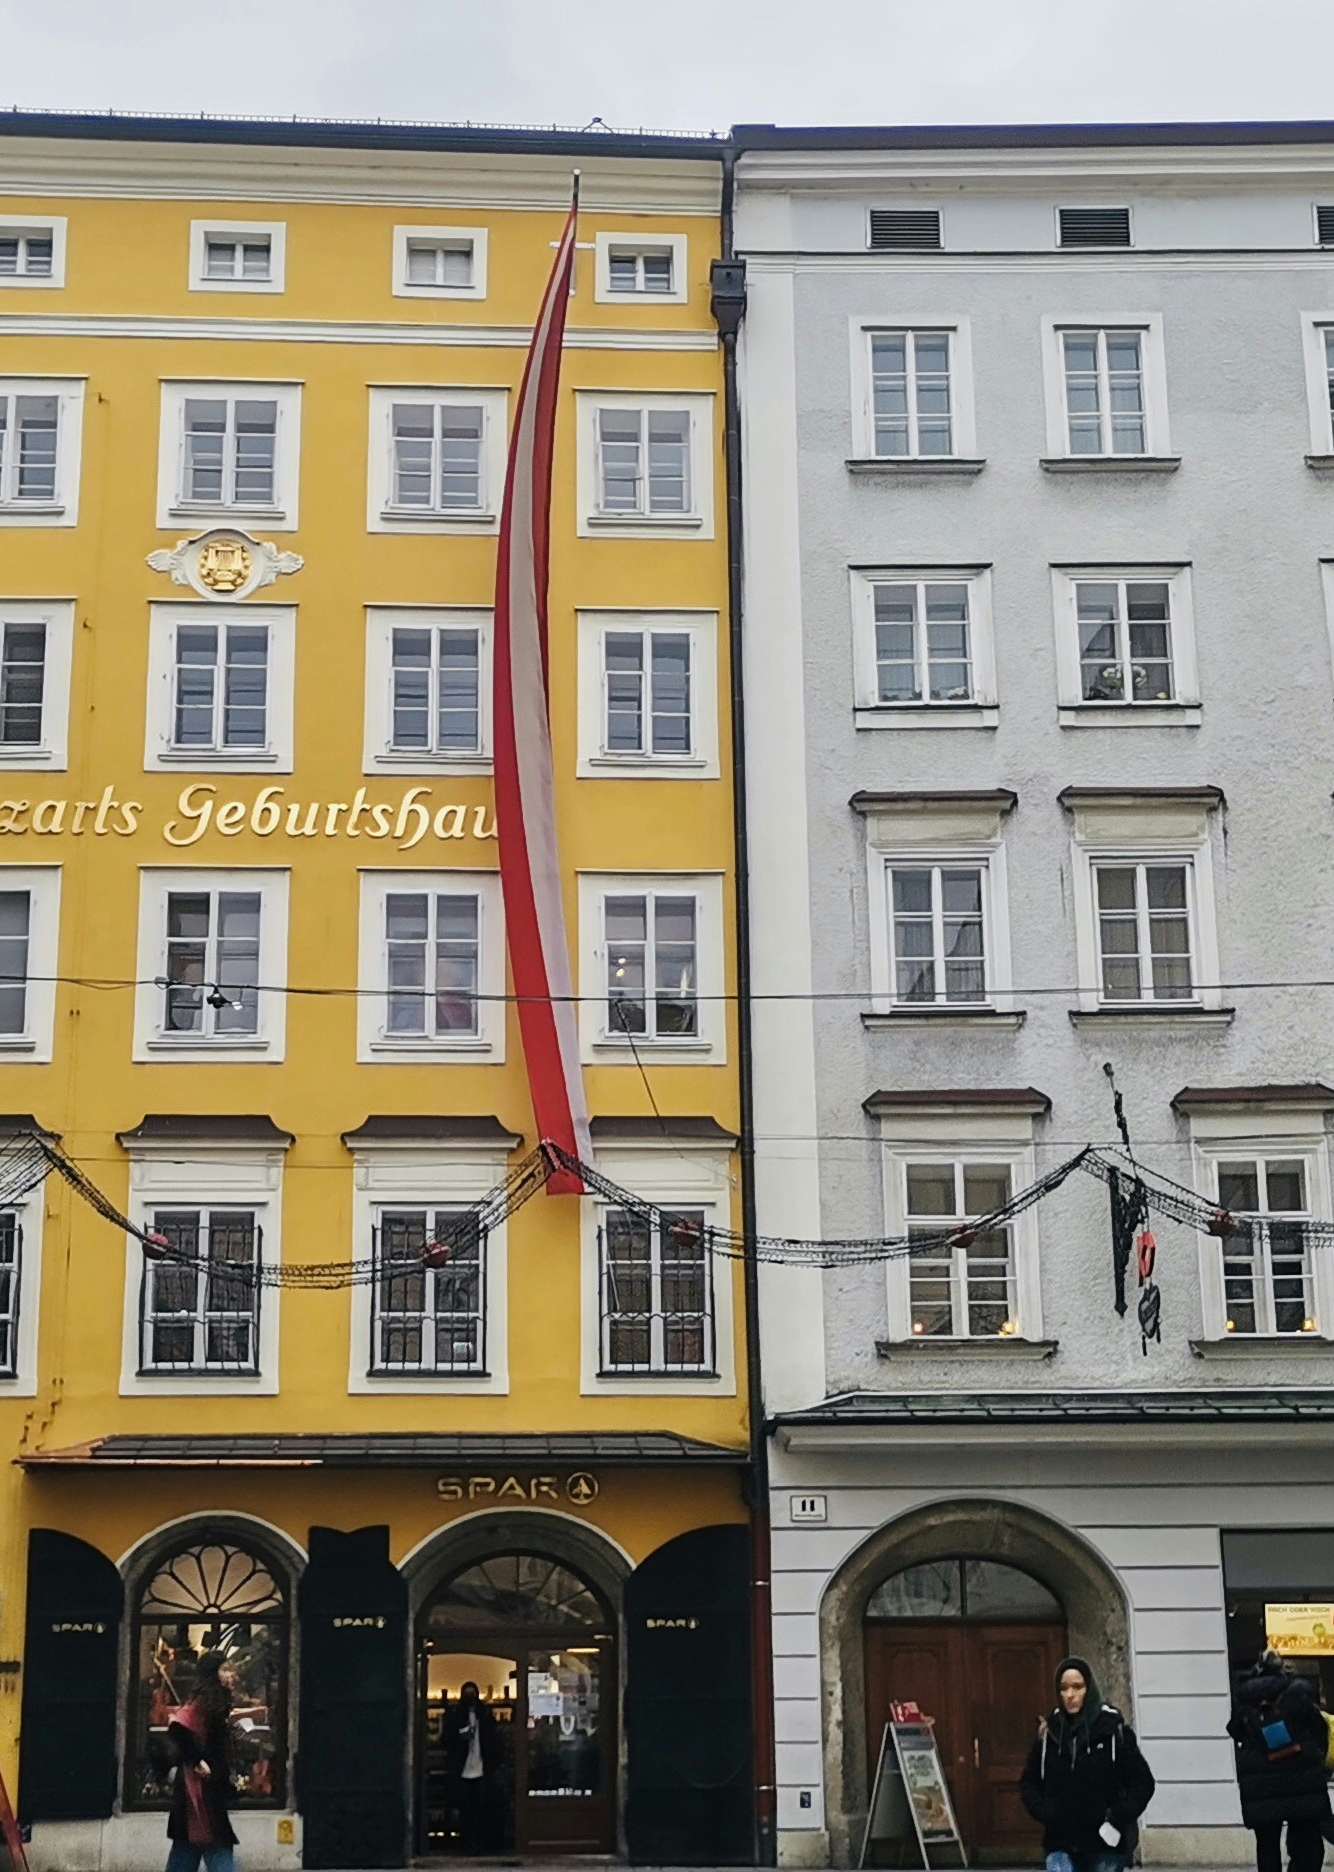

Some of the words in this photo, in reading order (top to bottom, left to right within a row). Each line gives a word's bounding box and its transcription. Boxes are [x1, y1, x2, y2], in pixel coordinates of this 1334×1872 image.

[163, 783, 500, 850] Geburtshau
[437, 1476, 558, 1500] SPAR
[801, 1499, 815, 1512] 11
[51, 1623, 93, 1632] SPAR
[333, 1617, 374, 1627] SPAR
[646, 1618, 686, 1628] SPAR
